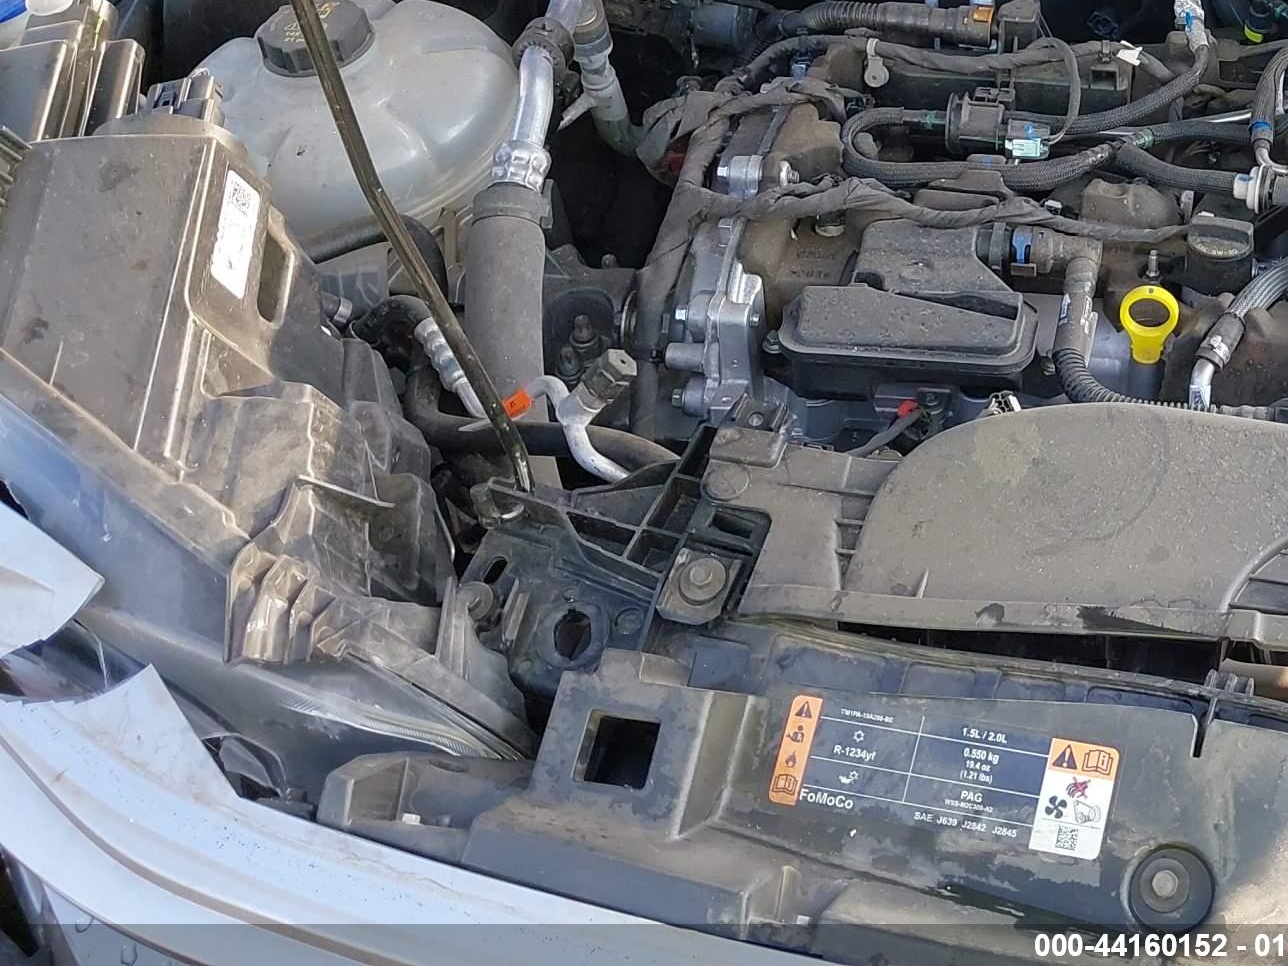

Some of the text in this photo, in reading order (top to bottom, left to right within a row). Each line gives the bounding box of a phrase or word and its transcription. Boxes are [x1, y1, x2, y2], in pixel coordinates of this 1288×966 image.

[962, 727, 982, 739] 1.5L
[987, 732, 1008, 744] 2.0L
[833, 744, 877, 763] R-1234yf
[963, 747, 1000, 765] 0.550 kg
[965, 760, 991, 772] 19.4 oz
[960, 770, 993, 785] (1.21 lbs)
[799, 788, 854, 810] FoMoCo
[960, 790, 983, 803] PAG
[913, 811, 1018, 838] SAE J639 J2842 J2845
